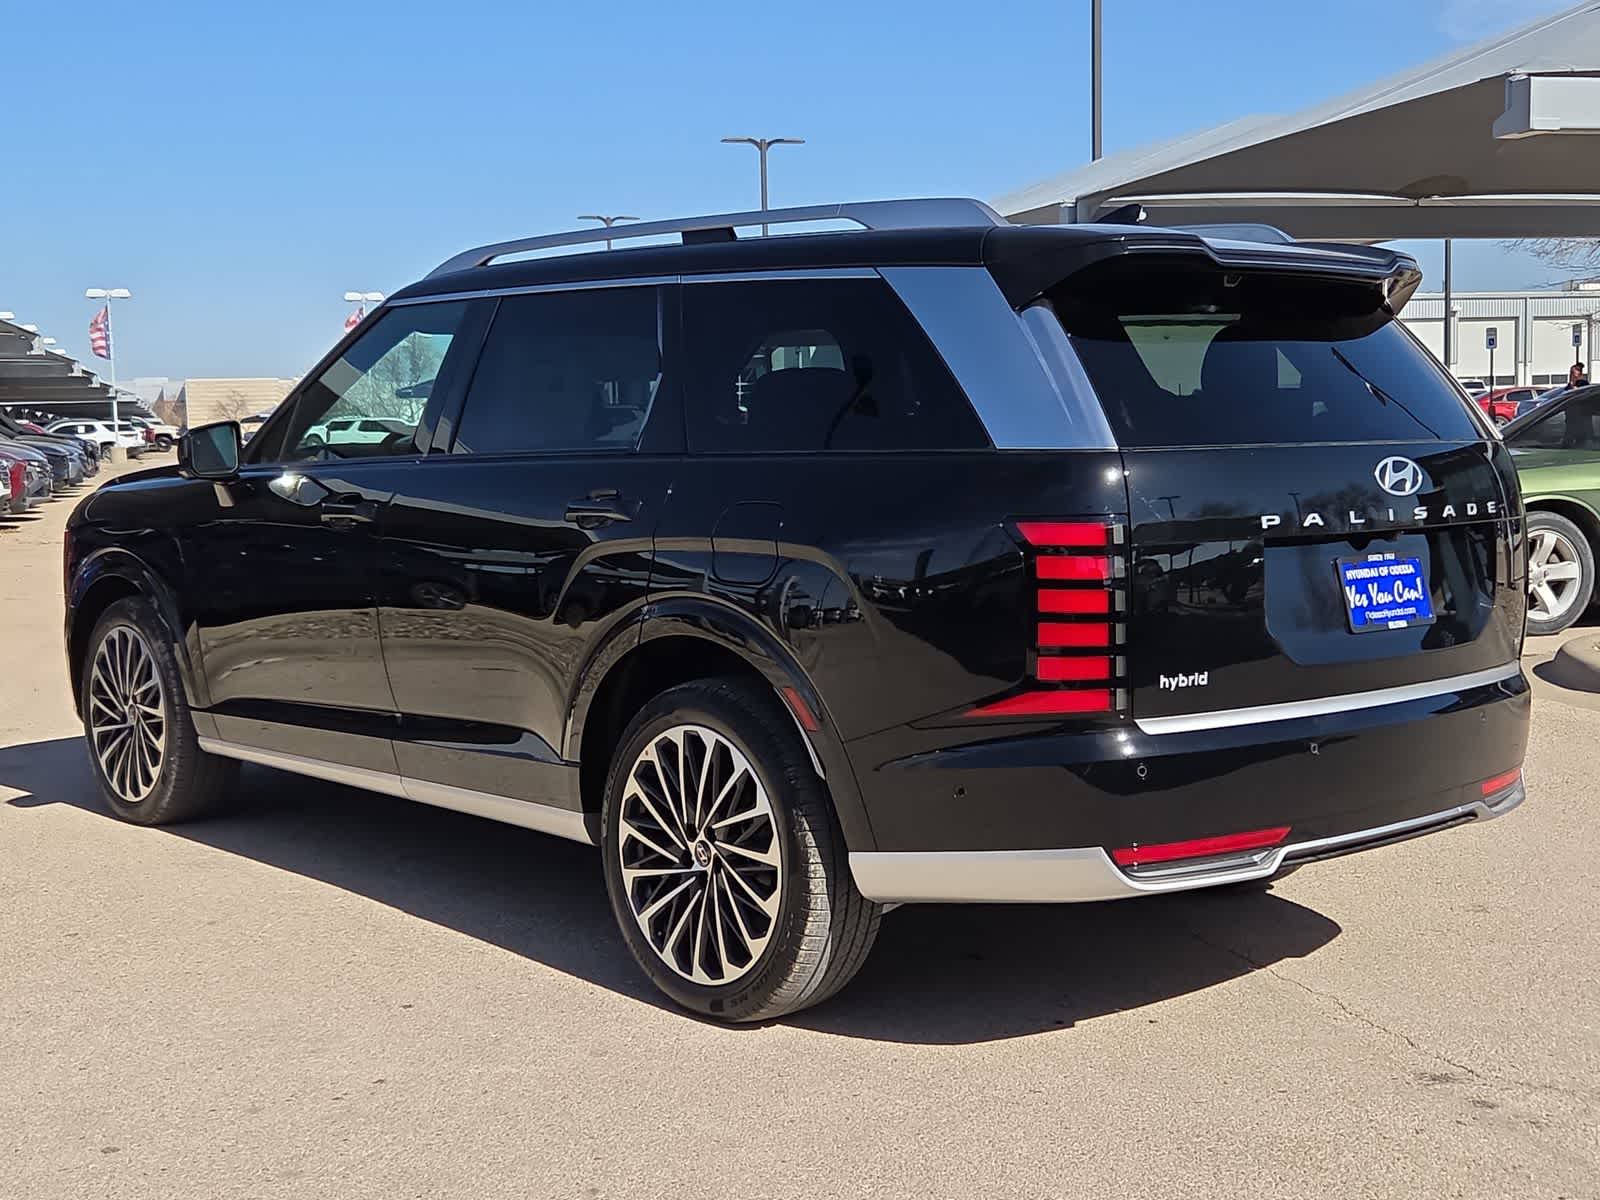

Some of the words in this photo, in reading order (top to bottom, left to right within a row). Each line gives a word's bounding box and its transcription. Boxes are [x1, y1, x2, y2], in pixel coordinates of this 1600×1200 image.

[1261, 501, 1496, 529] PALISADE
[1345, 567, 1379, 580] HYUNDAI
[1379, 566, 1389, 577] OF
[1389, 564, 1415, 576] ODESSA
[1345, 584, 1369, 609] Yes
[1368, 582, 1394, 606] You
[1393, 577, 1424, 603] Can!
[1159, 671, 1209, 692] hybrid
